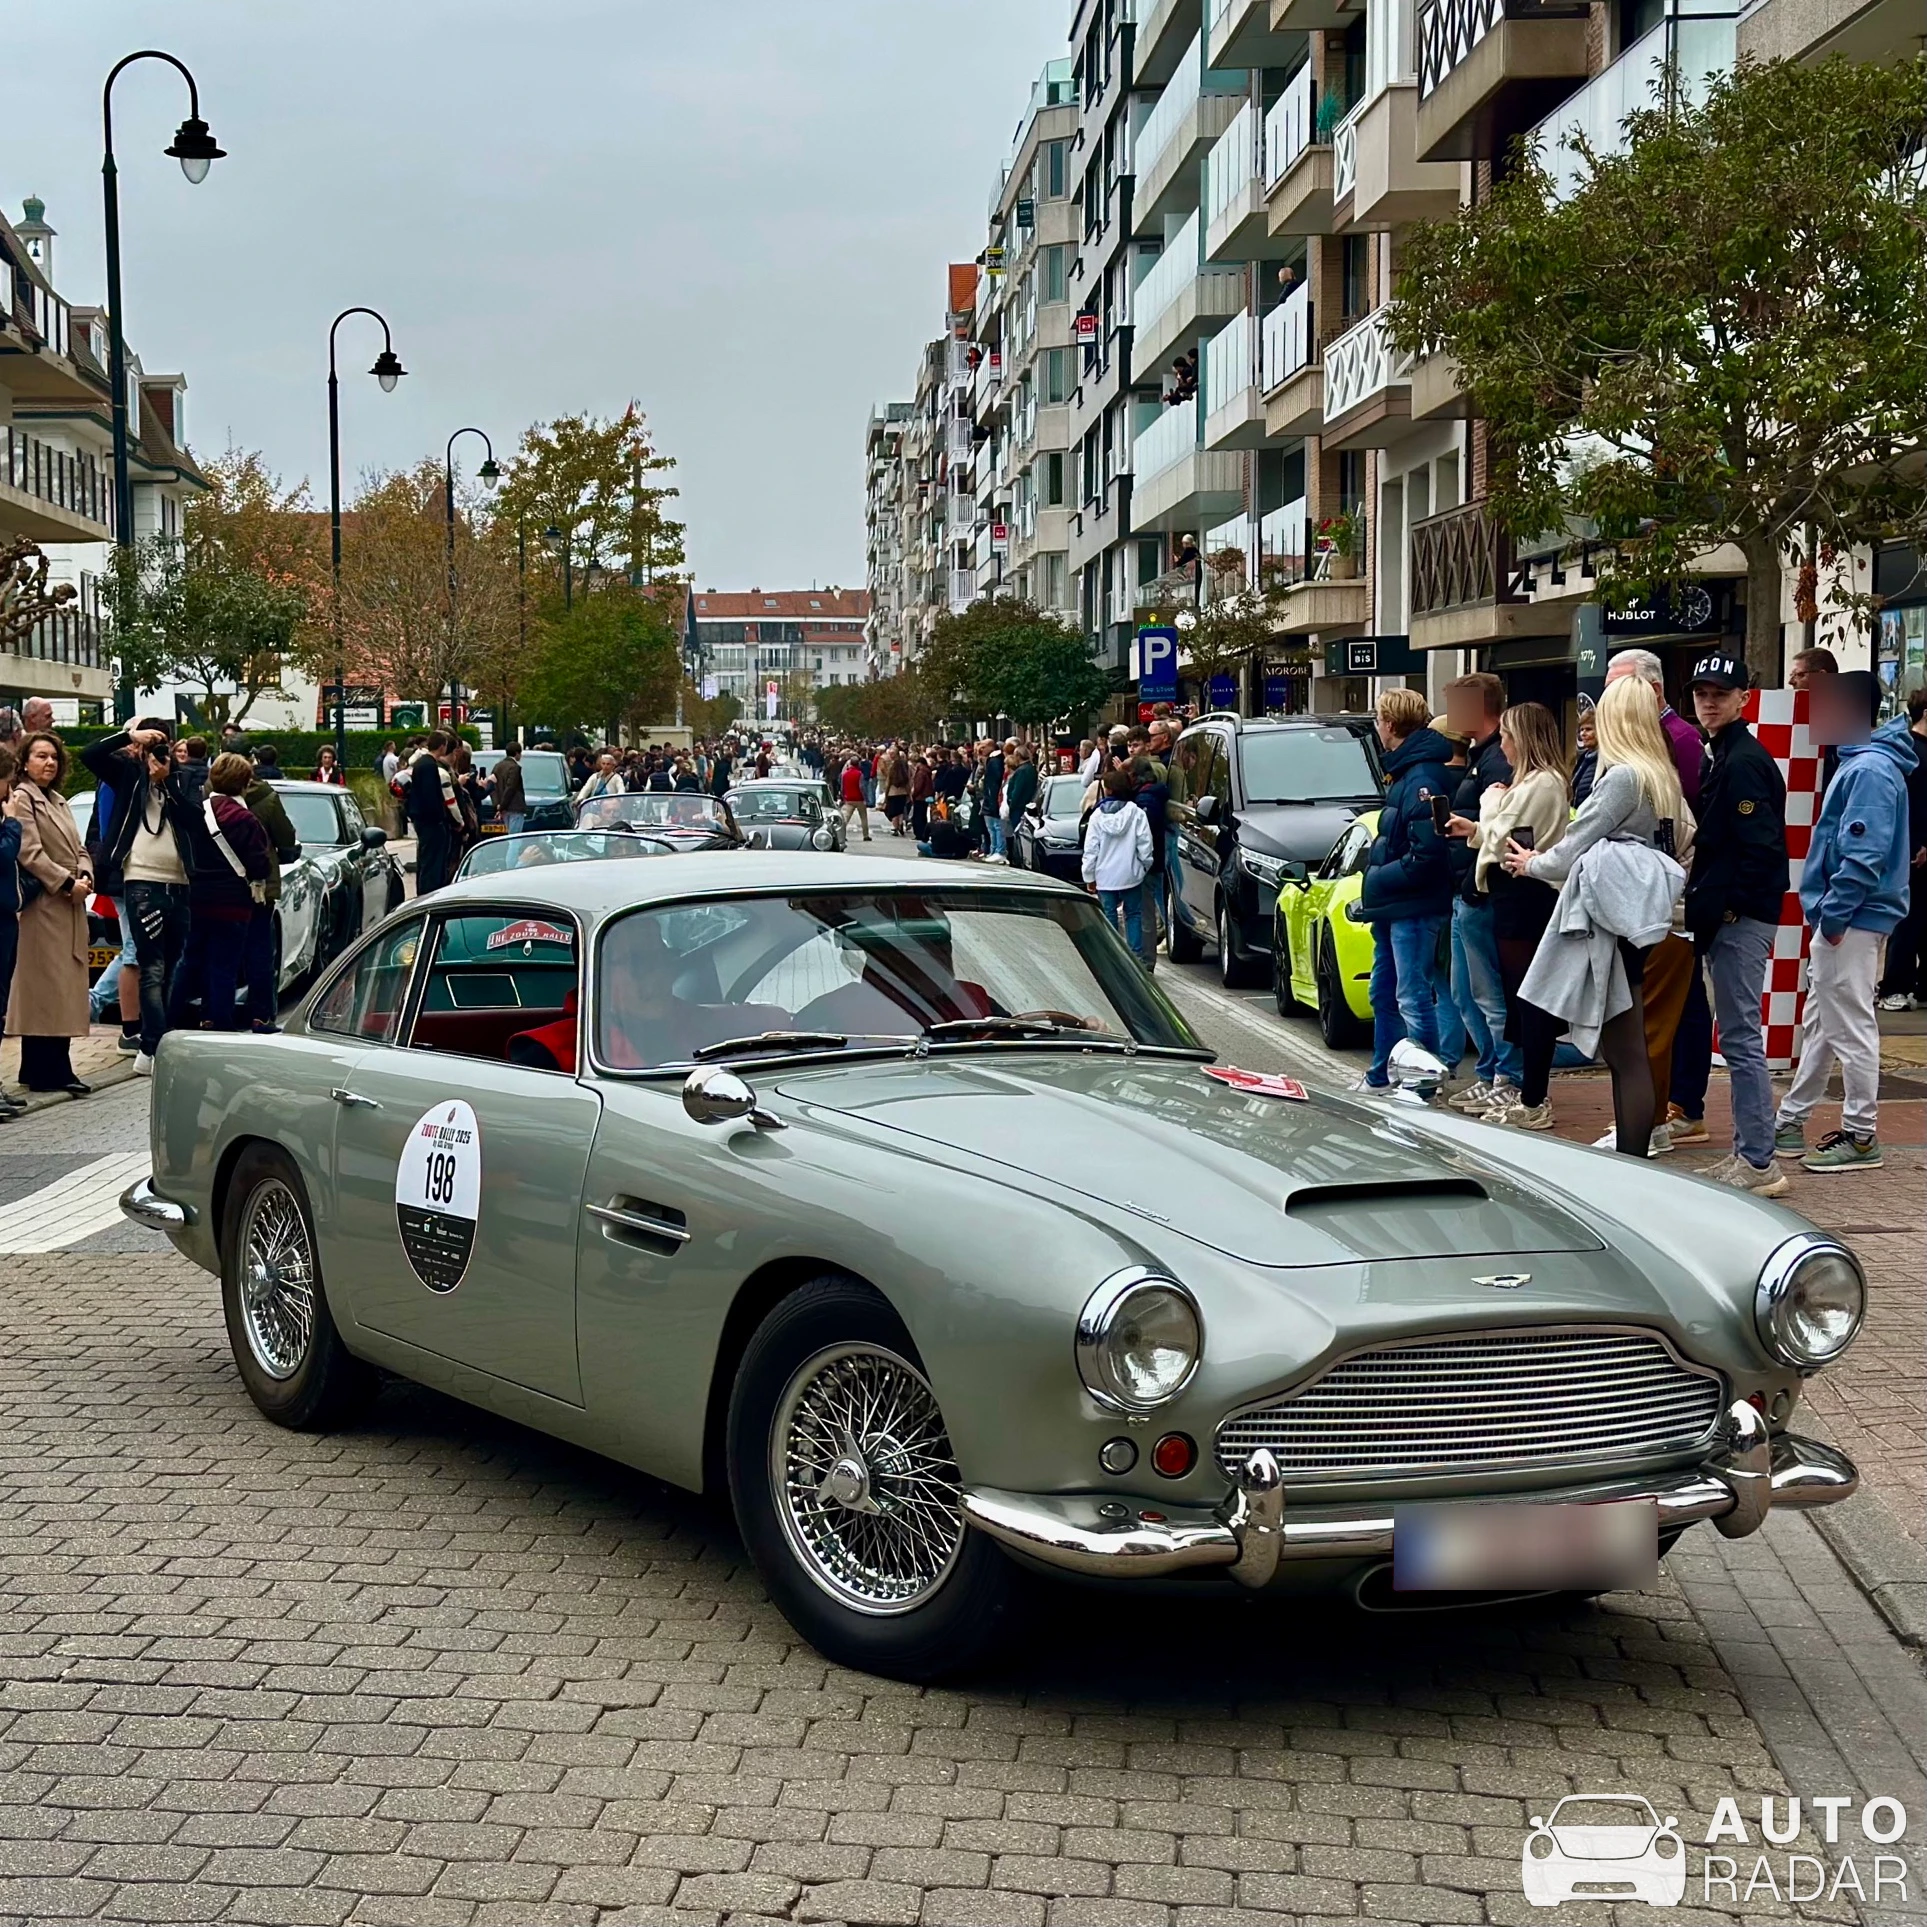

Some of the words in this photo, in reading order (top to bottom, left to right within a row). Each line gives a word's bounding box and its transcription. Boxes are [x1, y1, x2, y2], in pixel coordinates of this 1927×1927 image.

[1607, 610, 1656, 621] HUBLOT
[1144, 636, 1171, 675] P
[1265, 666, 1309, 676] MOROBE
[1693, 657, 1734, 677] ICON
[509, 931, 539, 940] ZOUTE
[543, 932, 570, 941] RALLY
[421, 1123, 440, 1139] ZOUTE
[439, 1126, 456, 1142] RALLY
[455, 1129, 472, 1145] 2025
[425, 1151, 456, 1204] 198
